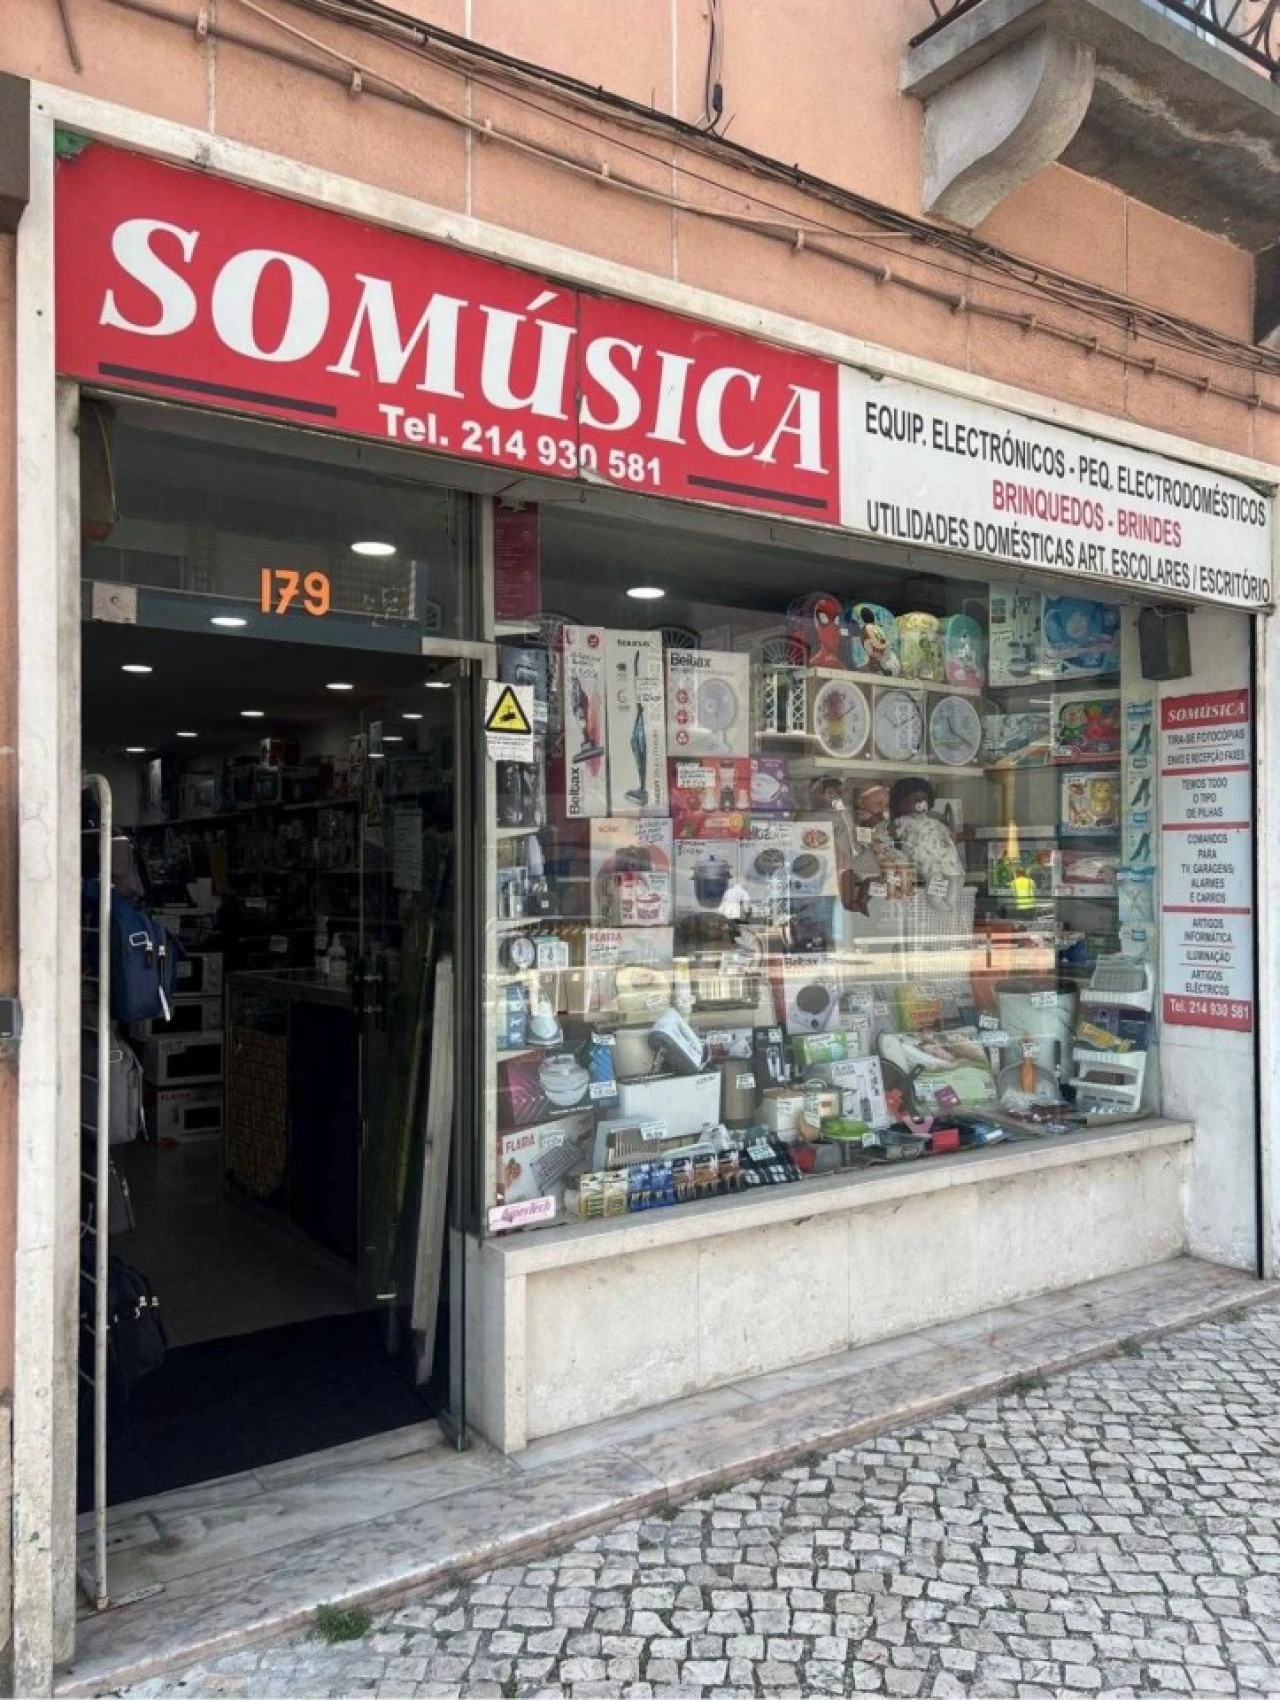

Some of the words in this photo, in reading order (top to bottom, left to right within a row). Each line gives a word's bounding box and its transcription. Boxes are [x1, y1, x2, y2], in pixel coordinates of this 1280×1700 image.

[98, 217, 829, 474] SOMÚSICA
[378, 404, 448, 446] Tel.
[461, 420, 526, 462] 214
[538, 437, 596, 475] 930
[608, 454, 663, 487] 581
[865, 401, 927, 446] EQUIP.
[932, 418, 1066, 478] ELECTRÓNICOS
[1079, 455, 1115, 490] PEQ.
[1117, 465, 1267, 526] ELECTRODOMÉSTICOS
[992, 479, 1104, 532] BRINQUEDOS
[1117, 509, 1182, 548] BRINDES
[866, 499, 970, 549] UTILIDADES
[973, 521, 1075, 568] DOMÉSTICAS
[1078, 546, 1108, 575] ART.
[1111, 548, 1190, 589] ESCOLARES
[1199, 565, 1271, 602] ESCRITÓRIO
[260, 567, 331, 616] 179
[671, 653, 711, 669] Belbax
[1167, 702, 1247, 723] SOMÚSICA
[1168, 733, 1195, 745] TIRA-SE
[1197, 728, 1246, 743] FOTOCÓPIAS
[1192, 749, 1224, 764] RECEPÇÃO
[1225, 749, 1246, 761] FAXES
[1182, 778, 1206, 790] TEMOS
[1207, 776, 1228, 789] TODO
[569, 766, 580, 815] Belbax
[1192, 793, 1199, 804] O
[1200, 793, 1217, 803] TIPO
[1186, 808, 1195, 819] DE
[1198, 807, 1224, 818] PILHAS
[1187, 834, 1228, 844] COMANDOS
[1198, 849, 1217, 860] PARA
[1191, 878, 1226, 889] ALARMES
[1189, 892, 1195, 904] E
[1196, 892, 1226, 904] CARROS
[1192, 918, 1224, 929] ARTIGOS
[1184, 930, 1233, 943] INFORMÁTICA
[1186, 949, 1231, 963] ILUMINAÇÃO
[1191, 969, 1223, 982] ARTIGOS
[1185, 982, 1230, 996] ELÉCTRICOS
[1170, 999, 1187, 1012] Tel.
[1189, 1000, 1207, 1014] 214
[1210, 1002, 1228, 1017] 930
[1231, 1003, 1249, 1020] 581
